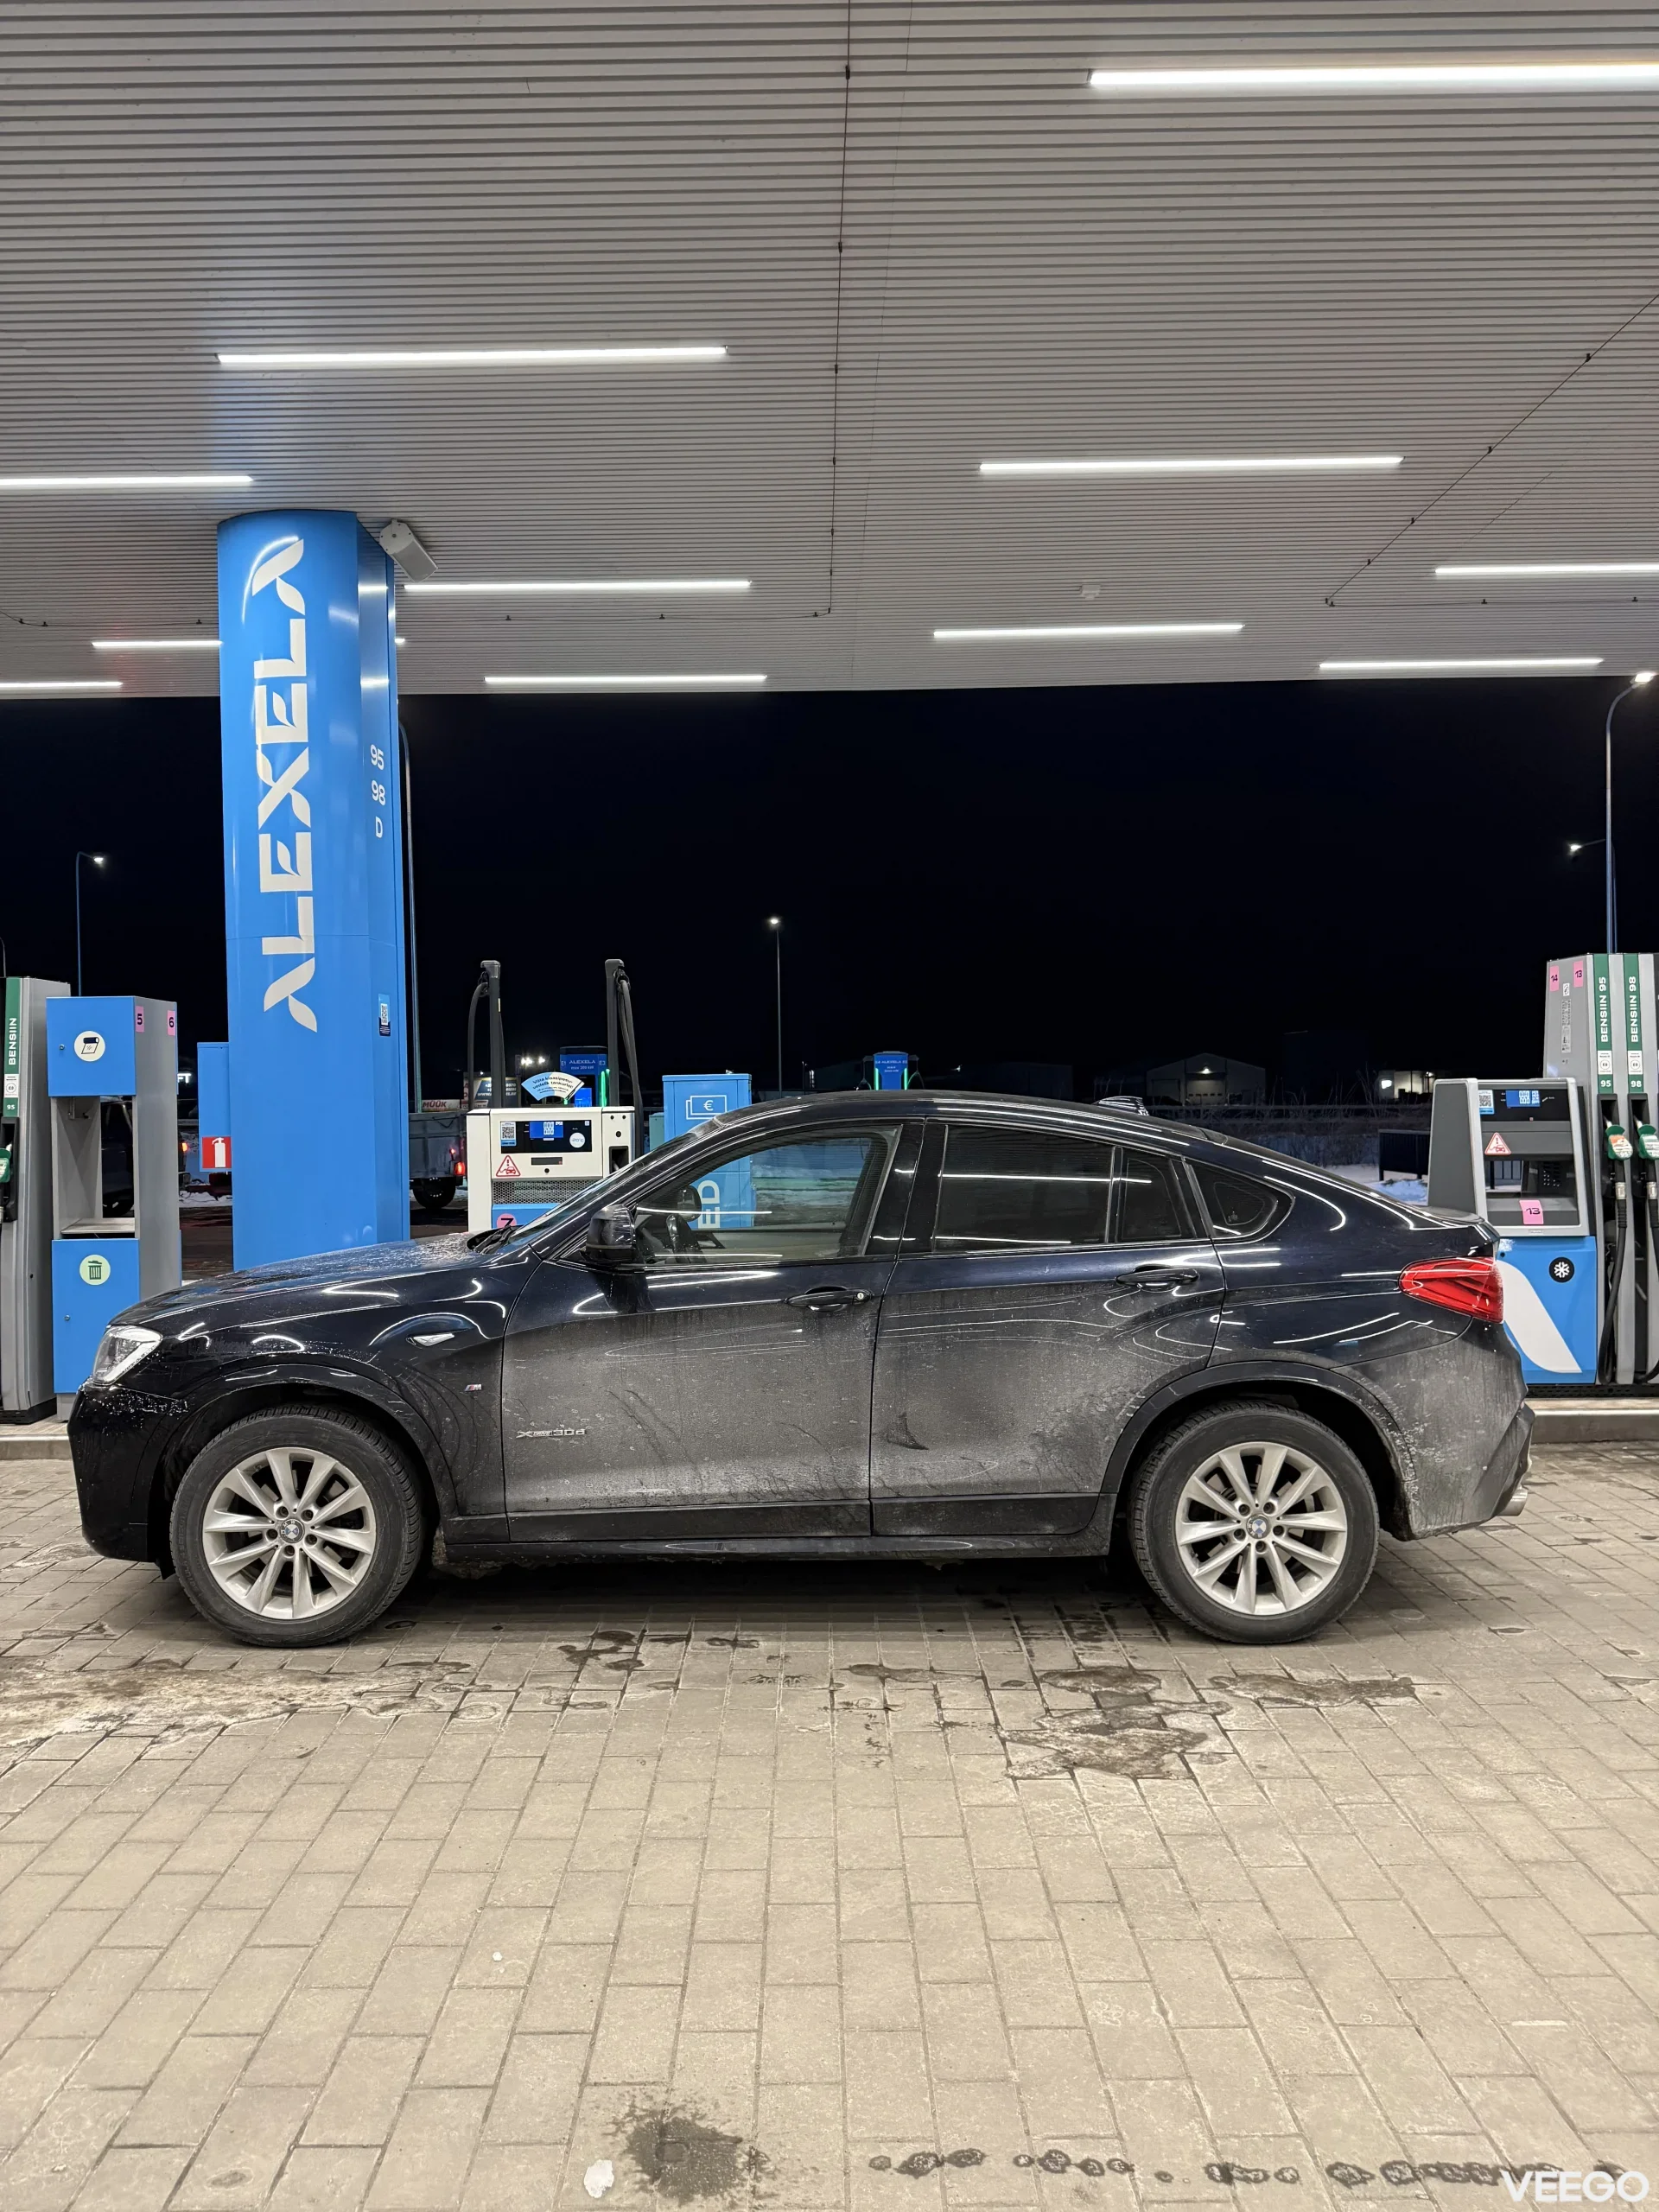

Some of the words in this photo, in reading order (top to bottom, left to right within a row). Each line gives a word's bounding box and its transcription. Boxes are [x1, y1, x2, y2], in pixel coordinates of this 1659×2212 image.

[370, 744, 385, 770] 95
[251, 537, 318, 1033] ALEXELA
[371, 779, 385, 806] 98
[375, 816, 383, 838] D
[1599, 976, 1606, 991] 95
[1629, 976, 1637, 991] 98
[137, 1013, 143, 1026] 5
[168, 1016, 175, 1028] 6
[1599, 995, 1608, 1042] BENSIIN
[1630, 995, 1638, 1042] BENSIIN
[9, 1018, 17, 1065] BENSIIN
